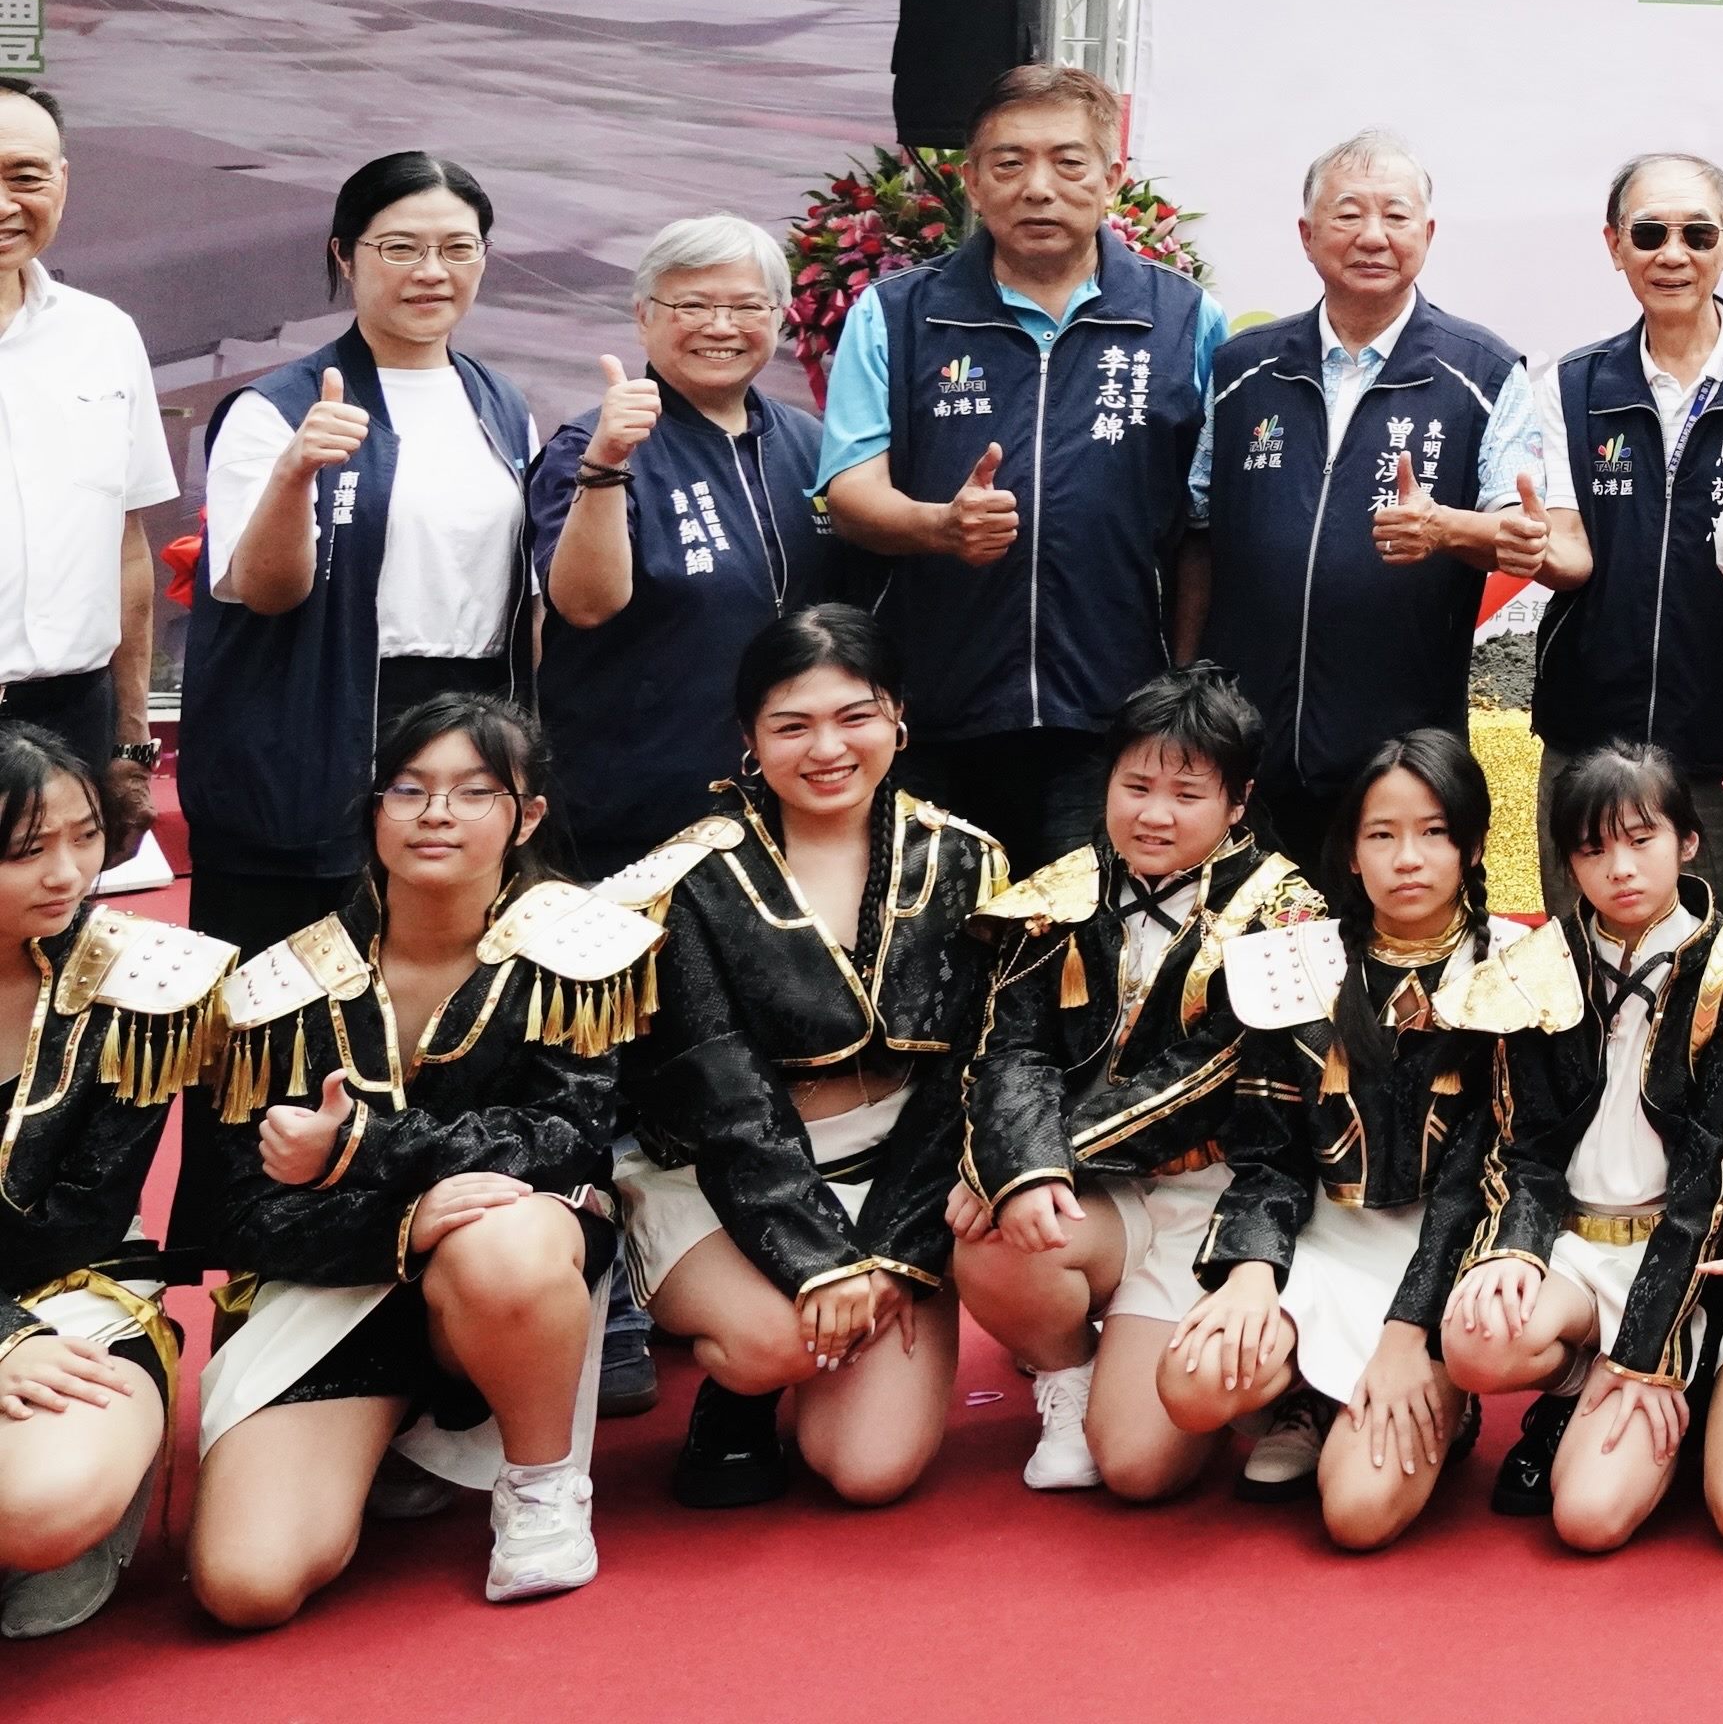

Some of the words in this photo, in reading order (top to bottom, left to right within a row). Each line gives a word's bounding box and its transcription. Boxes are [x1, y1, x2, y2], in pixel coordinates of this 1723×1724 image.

[938, 380, 987, 393] TAIPEI
[1090, 345, 1131, 446] 李志錦
[1128, 349, 1150, 426] 南港里里長
[933, 397, 993, 418] 南港區
[1249, 439, 1284, 452] TAIPEI
[1243, 453, 1282, 471] 南港區
[1594, 460, 1632, 473] TAIPEI
[1592, 478, 1633, 496] 南港區
[333, 471, 361, 525] 南港區
[690, 480, 731, 552] 南港區區長
[811, 514, 832, 526] TAI
[1489, 599, 1548, 622] 合建
